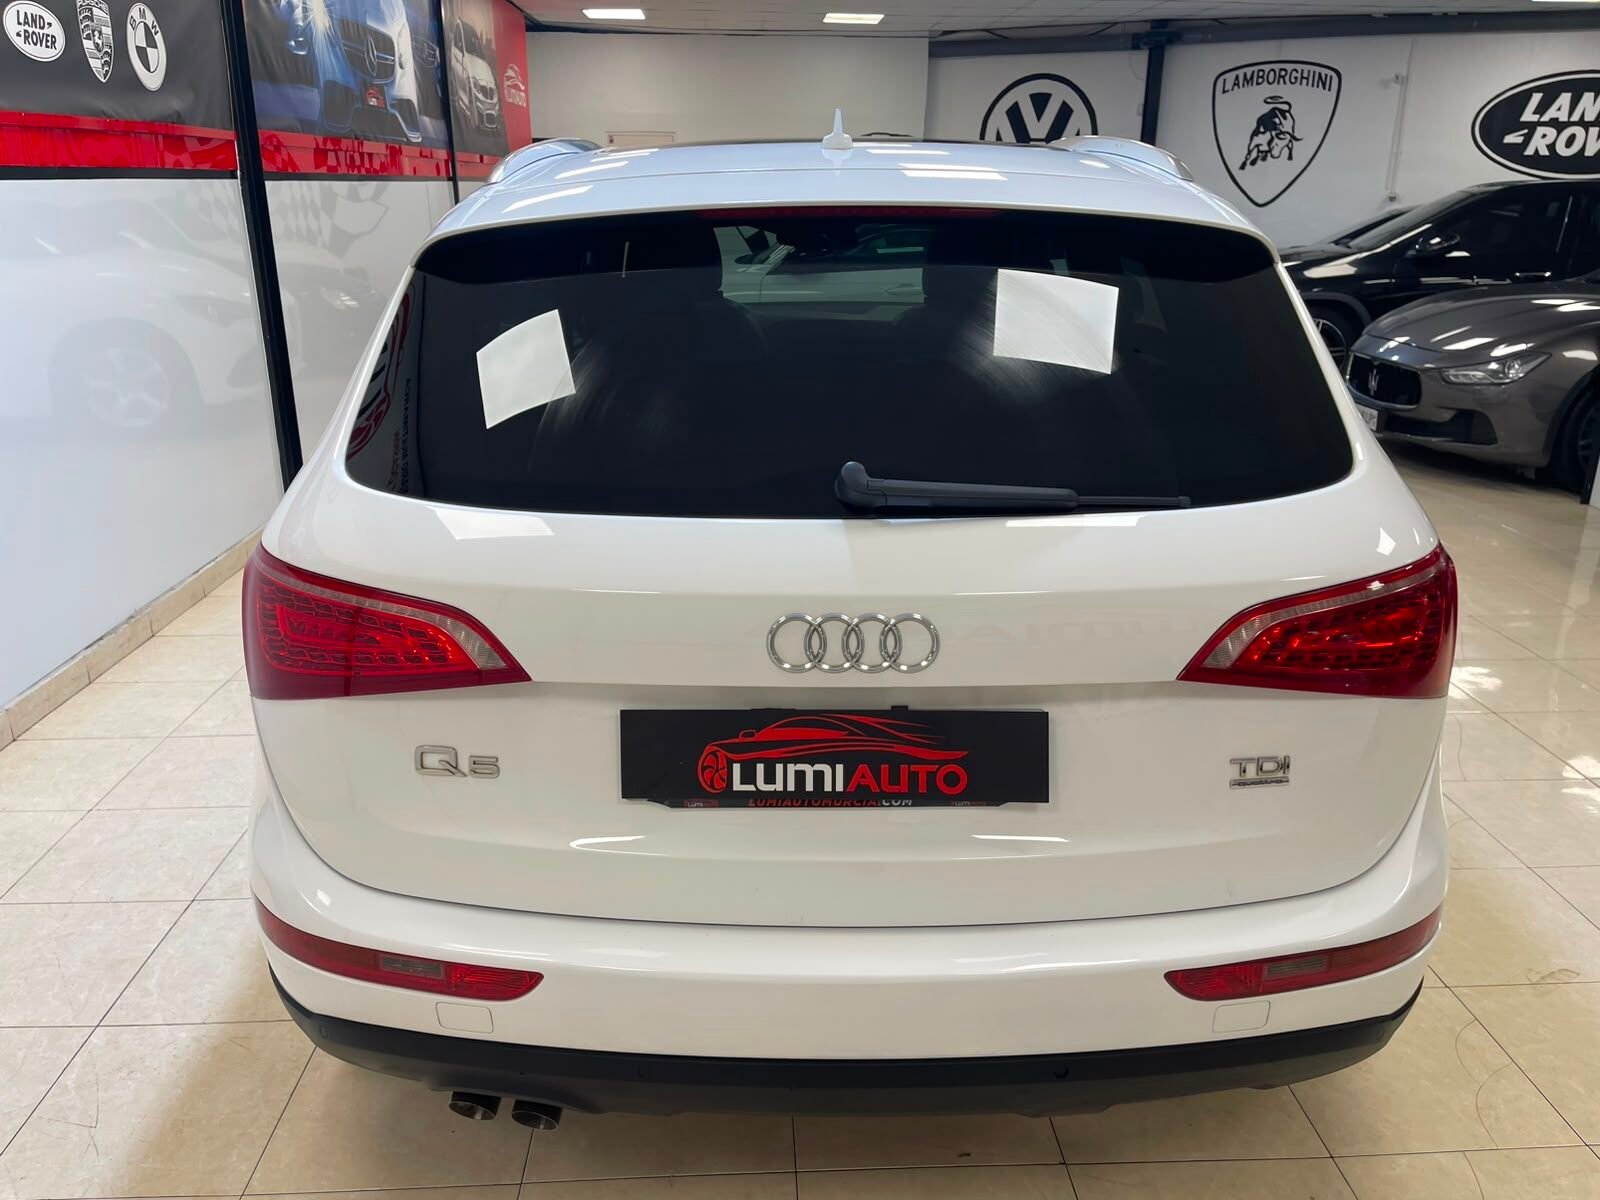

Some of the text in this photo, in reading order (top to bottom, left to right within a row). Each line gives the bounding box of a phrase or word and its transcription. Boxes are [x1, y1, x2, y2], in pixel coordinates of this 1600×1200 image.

[16, 9, 46, 30] LAND
[129, 8, 159, 36] BMW
[23, 29, 58, 51] ROVER
[1222, 68, 1333, 94] LAMBORGHINI
[1520, 92, 1600, 122] LAN
[1523, 125, 1600, 157] ROV
[414, 744, 500, 779] Q5
[1229, 755, 1290, 777] TDI
[732, 763, 968, 795] LUMIAUTO
